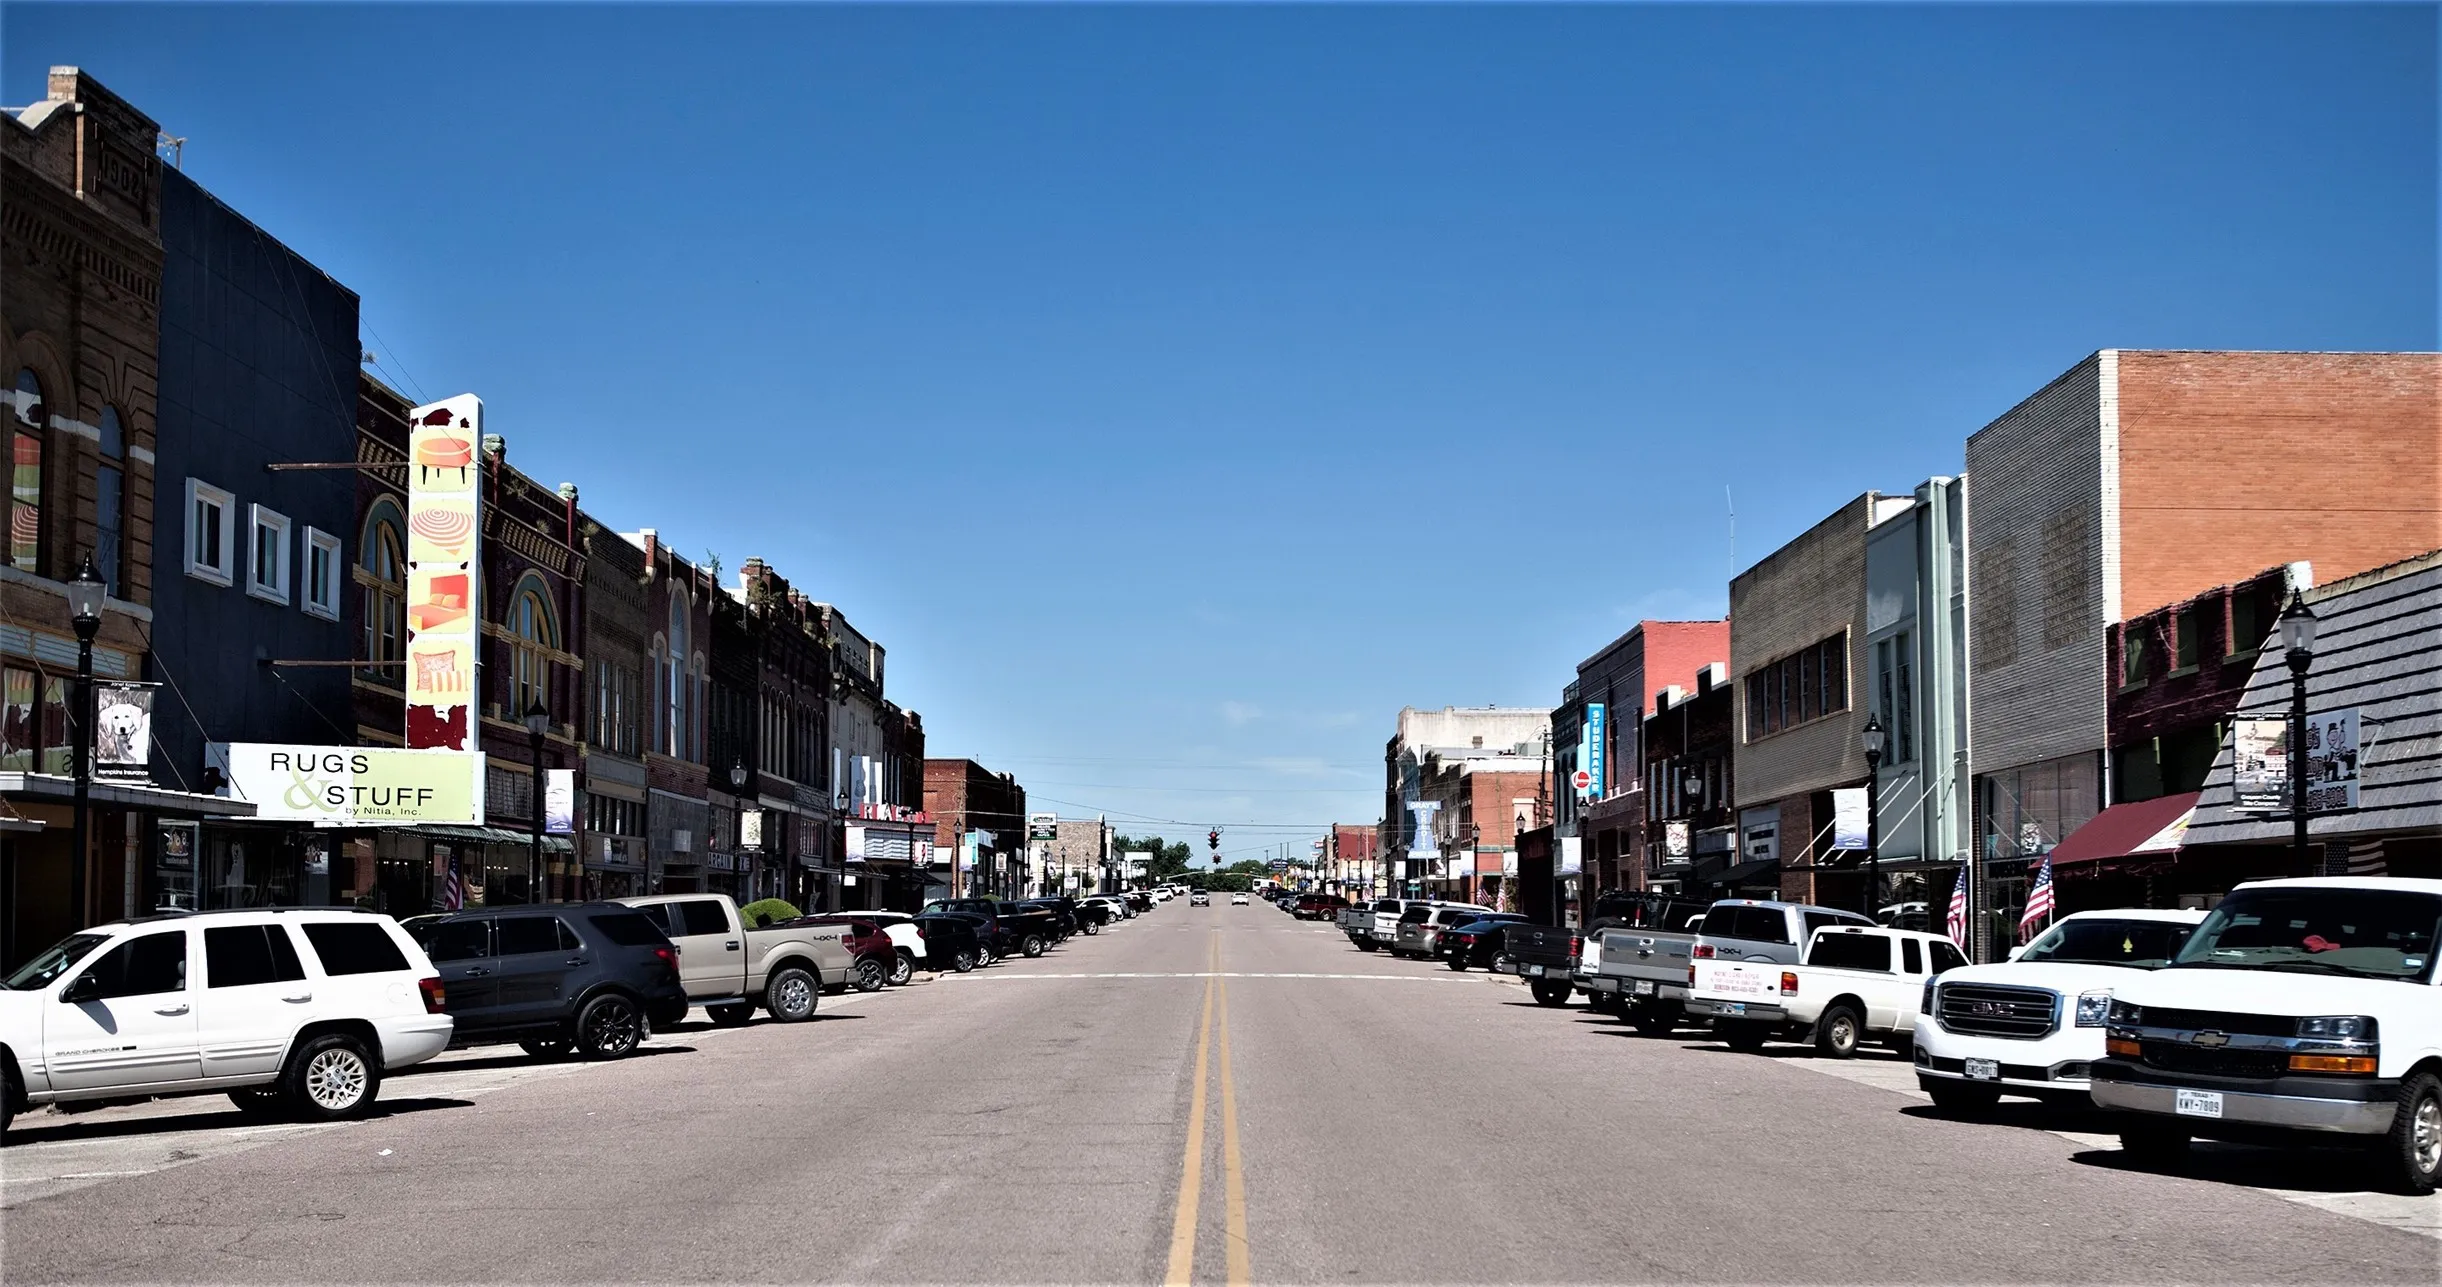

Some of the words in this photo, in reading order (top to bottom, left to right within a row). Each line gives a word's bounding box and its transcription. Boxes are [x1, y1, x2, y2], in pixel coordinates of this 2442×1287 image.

[104, 154, 140, 199] 1902
[271, 752, 369, 774] RUGS
[283, 764, 340, 812] &
[326, 785, 434, 807] STUFF
[346, 807, 359, 815] by
[364, 807, 395, 816] Nitia,
[400, 808, 421, 816] Inc.
[1410, 801, 1437, 809] GRAY'S
[1420, 810, 1428, 850] CREDIT
[1972, 1002, 2015, 1017] GMC
[82, 1046, 120, 1055] CHEROKEE
